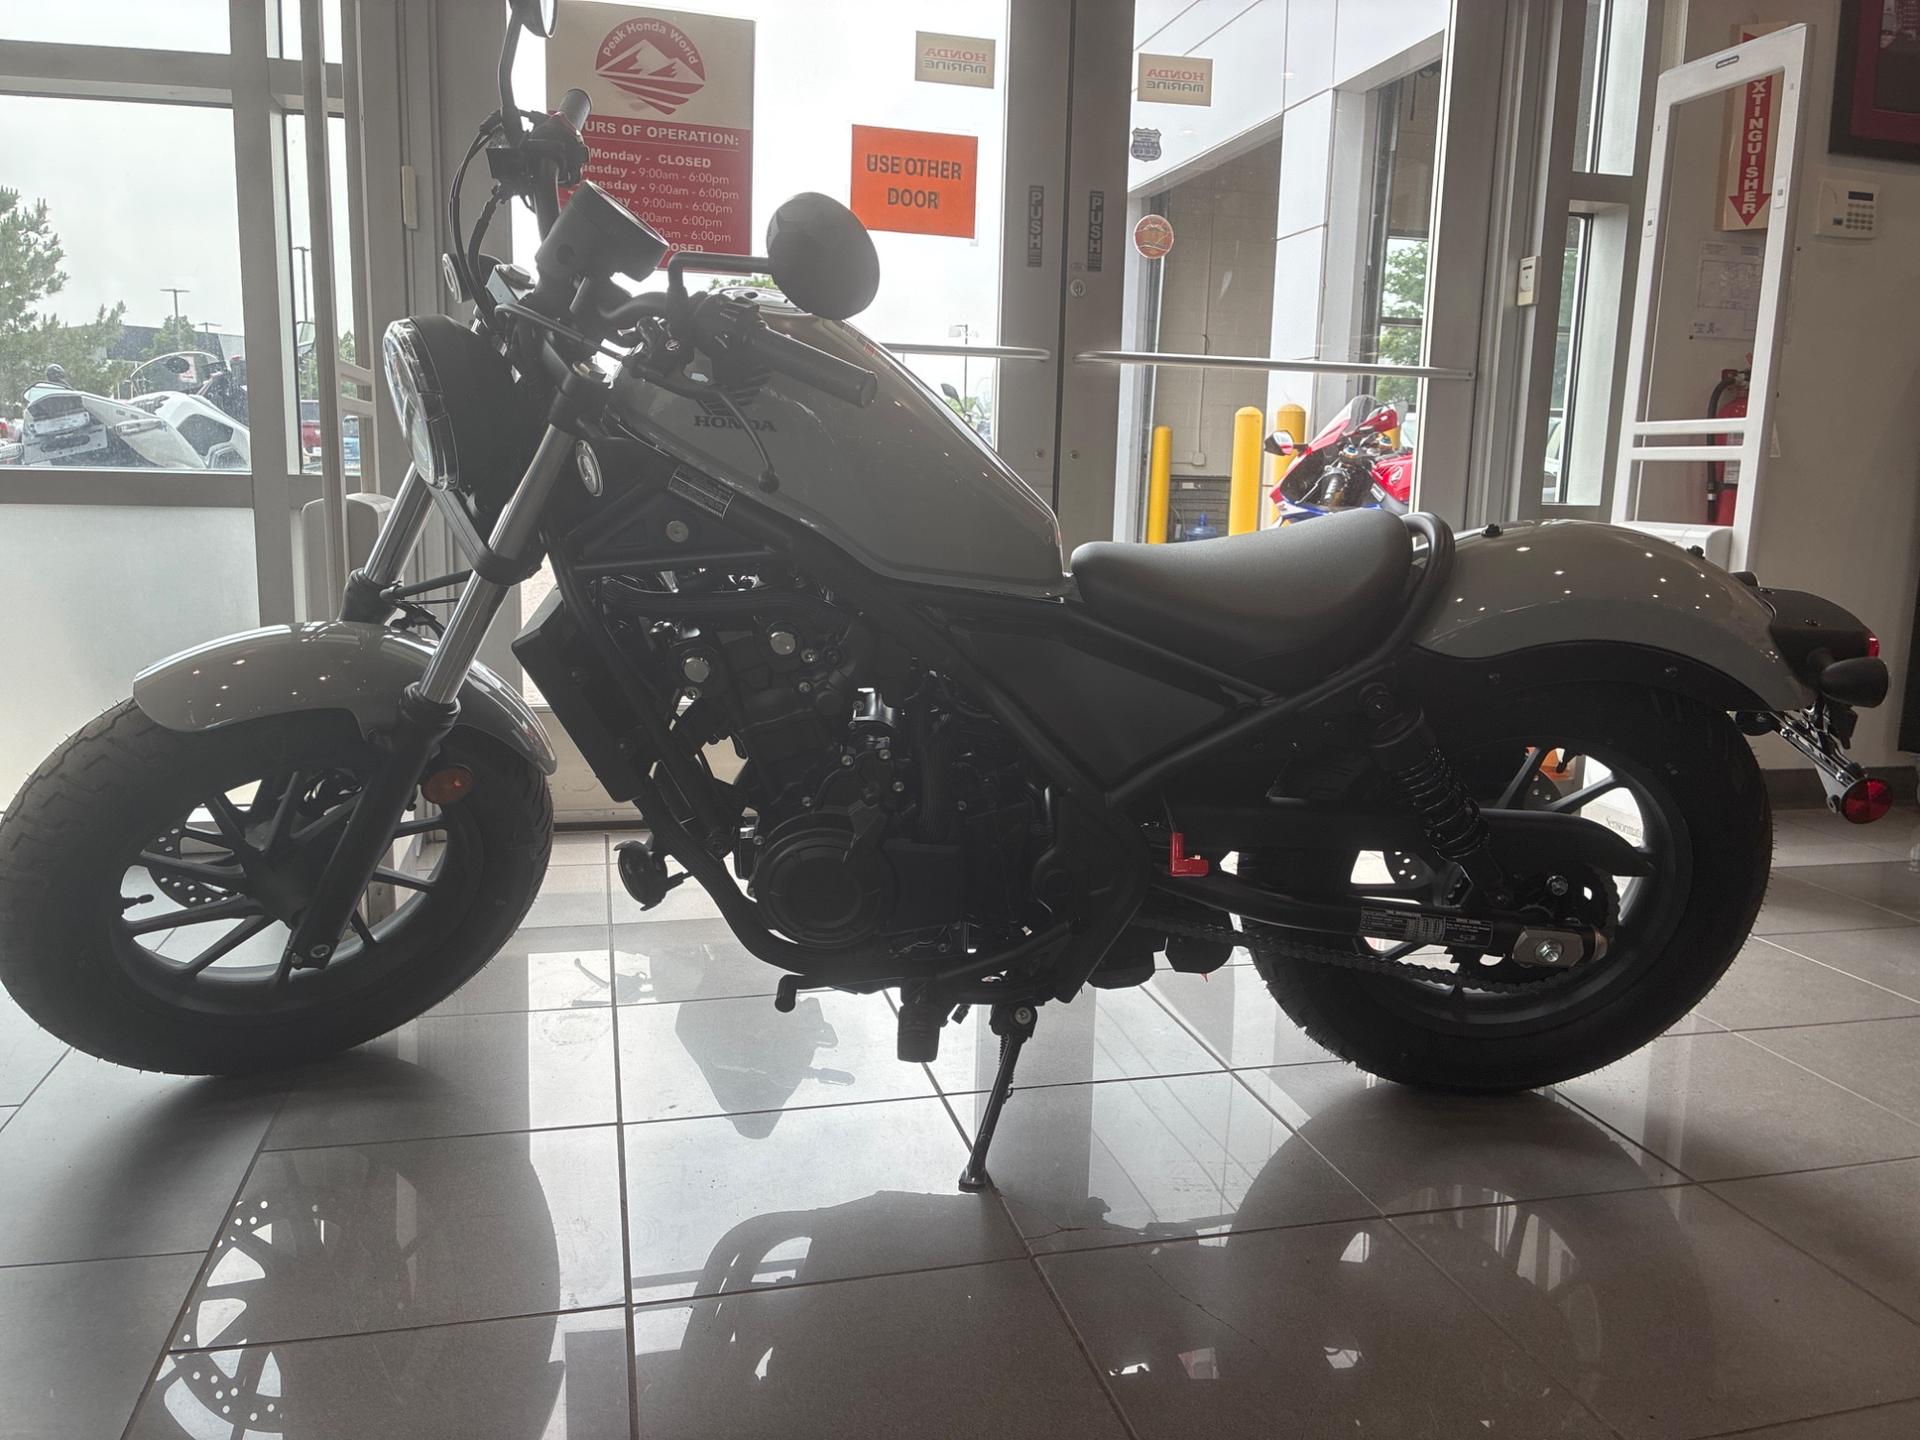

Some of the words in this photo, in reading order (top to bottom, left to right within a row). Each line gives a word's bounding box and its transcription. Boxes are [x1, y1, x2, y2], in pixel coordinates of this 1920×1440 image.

[603, 30, 627, 57] Peak
[626, 22, 667, 34] Honda
[670, 29, 699, 64] World
[585, 121, 616, 134] URS
[622, 124, 642, 136] OF
[647, 127, 739, 145] OPERATION:
[1742, 80, 1767, 213] XTINGUISHER
[591, 149, 642, 164] Monday
[658, 154, 711, 168] CLOSED
[866, 153, 901, 174] USE
[905, 157, 962, 180] OTHER
[583, 164, 627, 178] uesday
[638, 167, 679, 180] 9:00am
[689, 172, 730, 186] 6:00pm
[649, 183, 688, 196] 9:00am
[698, 187, 739, 201] 6:00pm
[887, 187, 939, 209] DOOR
[642, 197, 682, 209] 9:00am
[692, 202, 733, 216] 6:00pm
[681, 214, 722, 228] 6:00pm
[1030, 190, 1042, 249] PUSH
[1090, 195, 1102, 253] PUSH
[669, 242, 704, 252] OSED
[691, 229, 732, 243] 6:00pm
